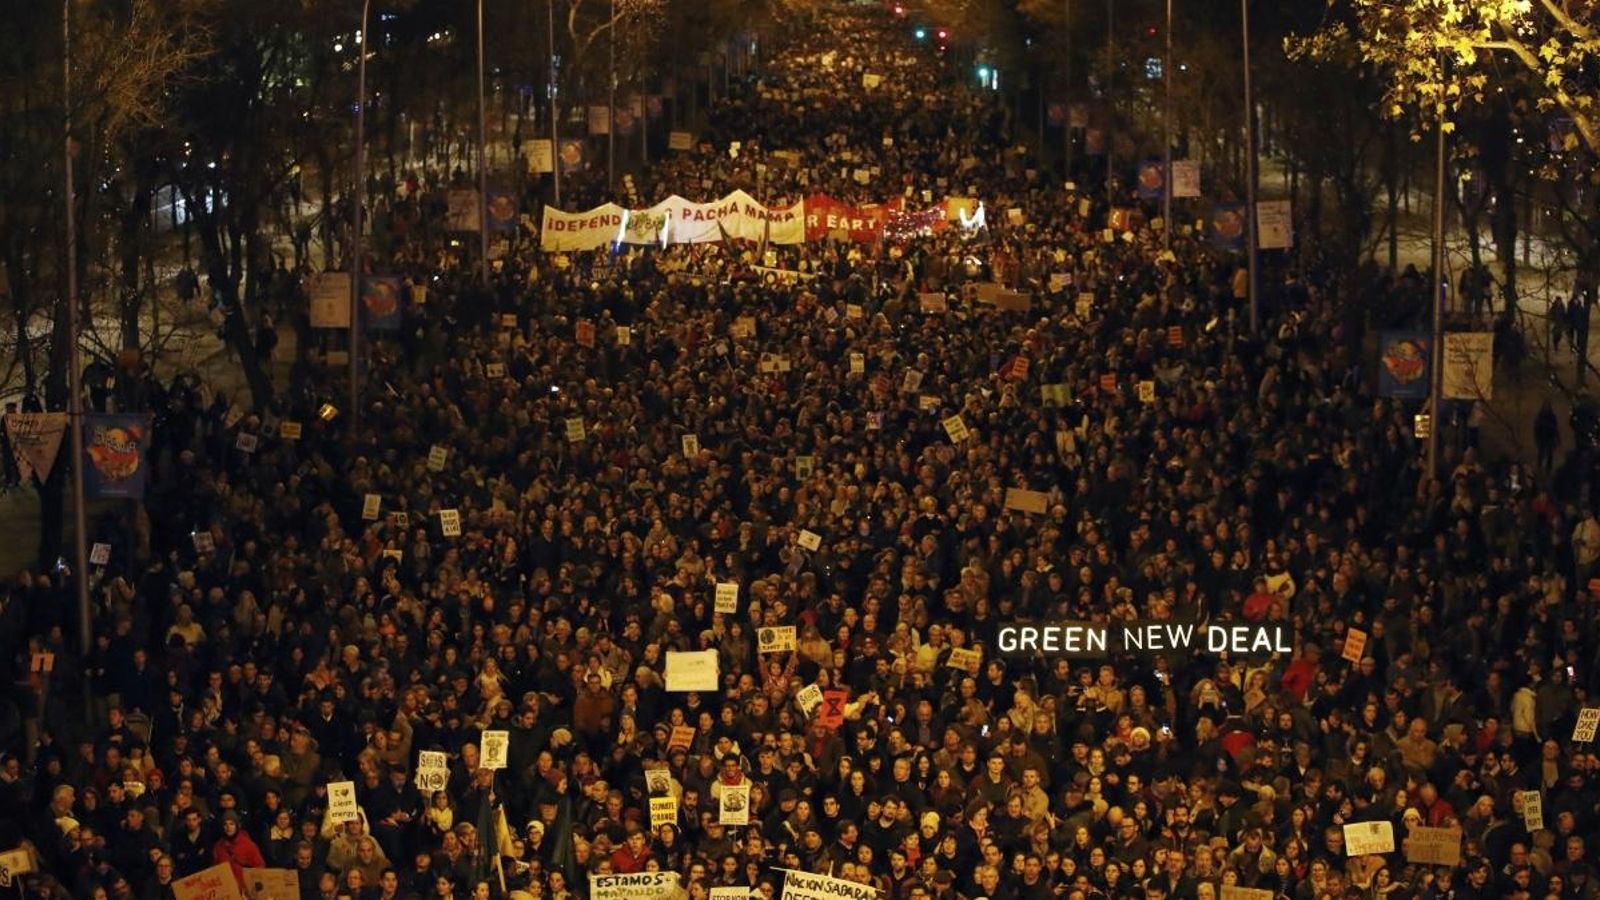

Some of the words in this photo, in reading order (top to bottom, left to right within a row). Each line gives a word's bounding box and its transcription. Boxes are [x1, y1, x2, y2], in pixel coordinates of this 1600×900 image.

[682, 203, 739, 222] PACHA
[998, 627, 1107, 651] GREEN
[1123, 625, 1194, 650] NEW
[1207, 626, 1292, 653] DEAL
[651, 812, 676, 822] CHANGE
[596, 872, 665, 888] ESTAMOS
[785, 871, 824, 892] NACION
[597, 887, 665, 899] MATANDO
